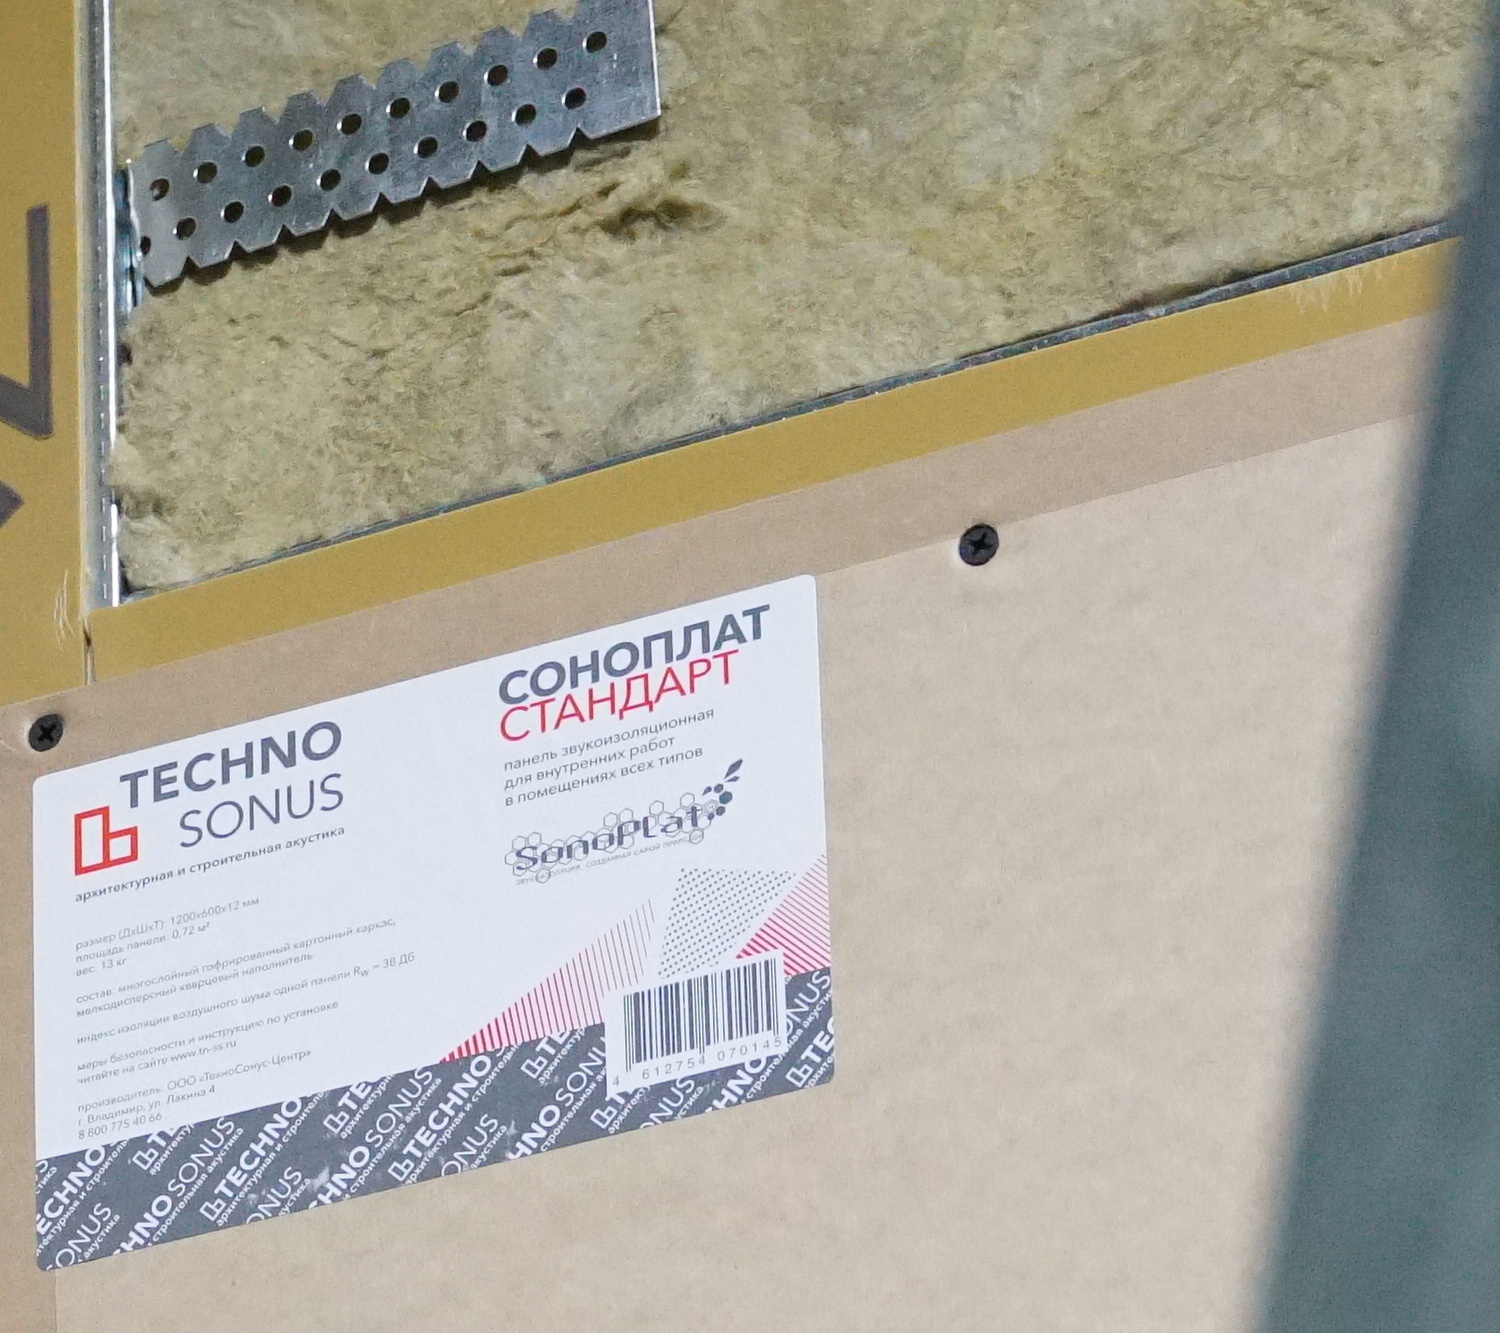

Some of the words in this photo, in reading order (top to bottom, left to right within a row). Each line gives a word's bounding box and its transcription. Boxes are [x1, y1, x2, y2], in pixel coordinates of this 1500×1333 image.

[497, 602, 771, 706] СОНОПЛАТ
[498, 647, 740, 742] СТАНДАРТ
[118, 719, 342, 809] TECHNO
[502, 749, 558, 772] панель
[560, 707, 715, 757] звукоизоляционная
[502, 772, 533, 793] для
[535, 748, 626, 781] внутренних
[628, 735, 675, 761] работ
[503, 795, 514, 807] в
[516, 768, 617, 804] помещениях
[619, 758, 655, 777] всех
[656, 746, 704, 768] типов
[178, 771, 344, 848] SONUS
[514, 801, 703, 873] SonoPlat
[73, 868, 174, 904] архитектурная
[176, 866, 186, 877] и
[188, 841, 282, 874] строительная
[283, 825, 346, 850] акустика
[100, 957, 114, 970] 13
[360, 1063, 437, 1149] SONUS
[398, 1050, 497, 1163] TECHNO
[611, 1074, 620, 1087] 4
[77, 1128, 85, 1140] 8
[86, 1123, 108, 1138] 800
[210, 1093, 307, 1203] TECHNO
[110, 1190, 177, 1254] HNO
[163, 1114, 239, 1198] SONUS
